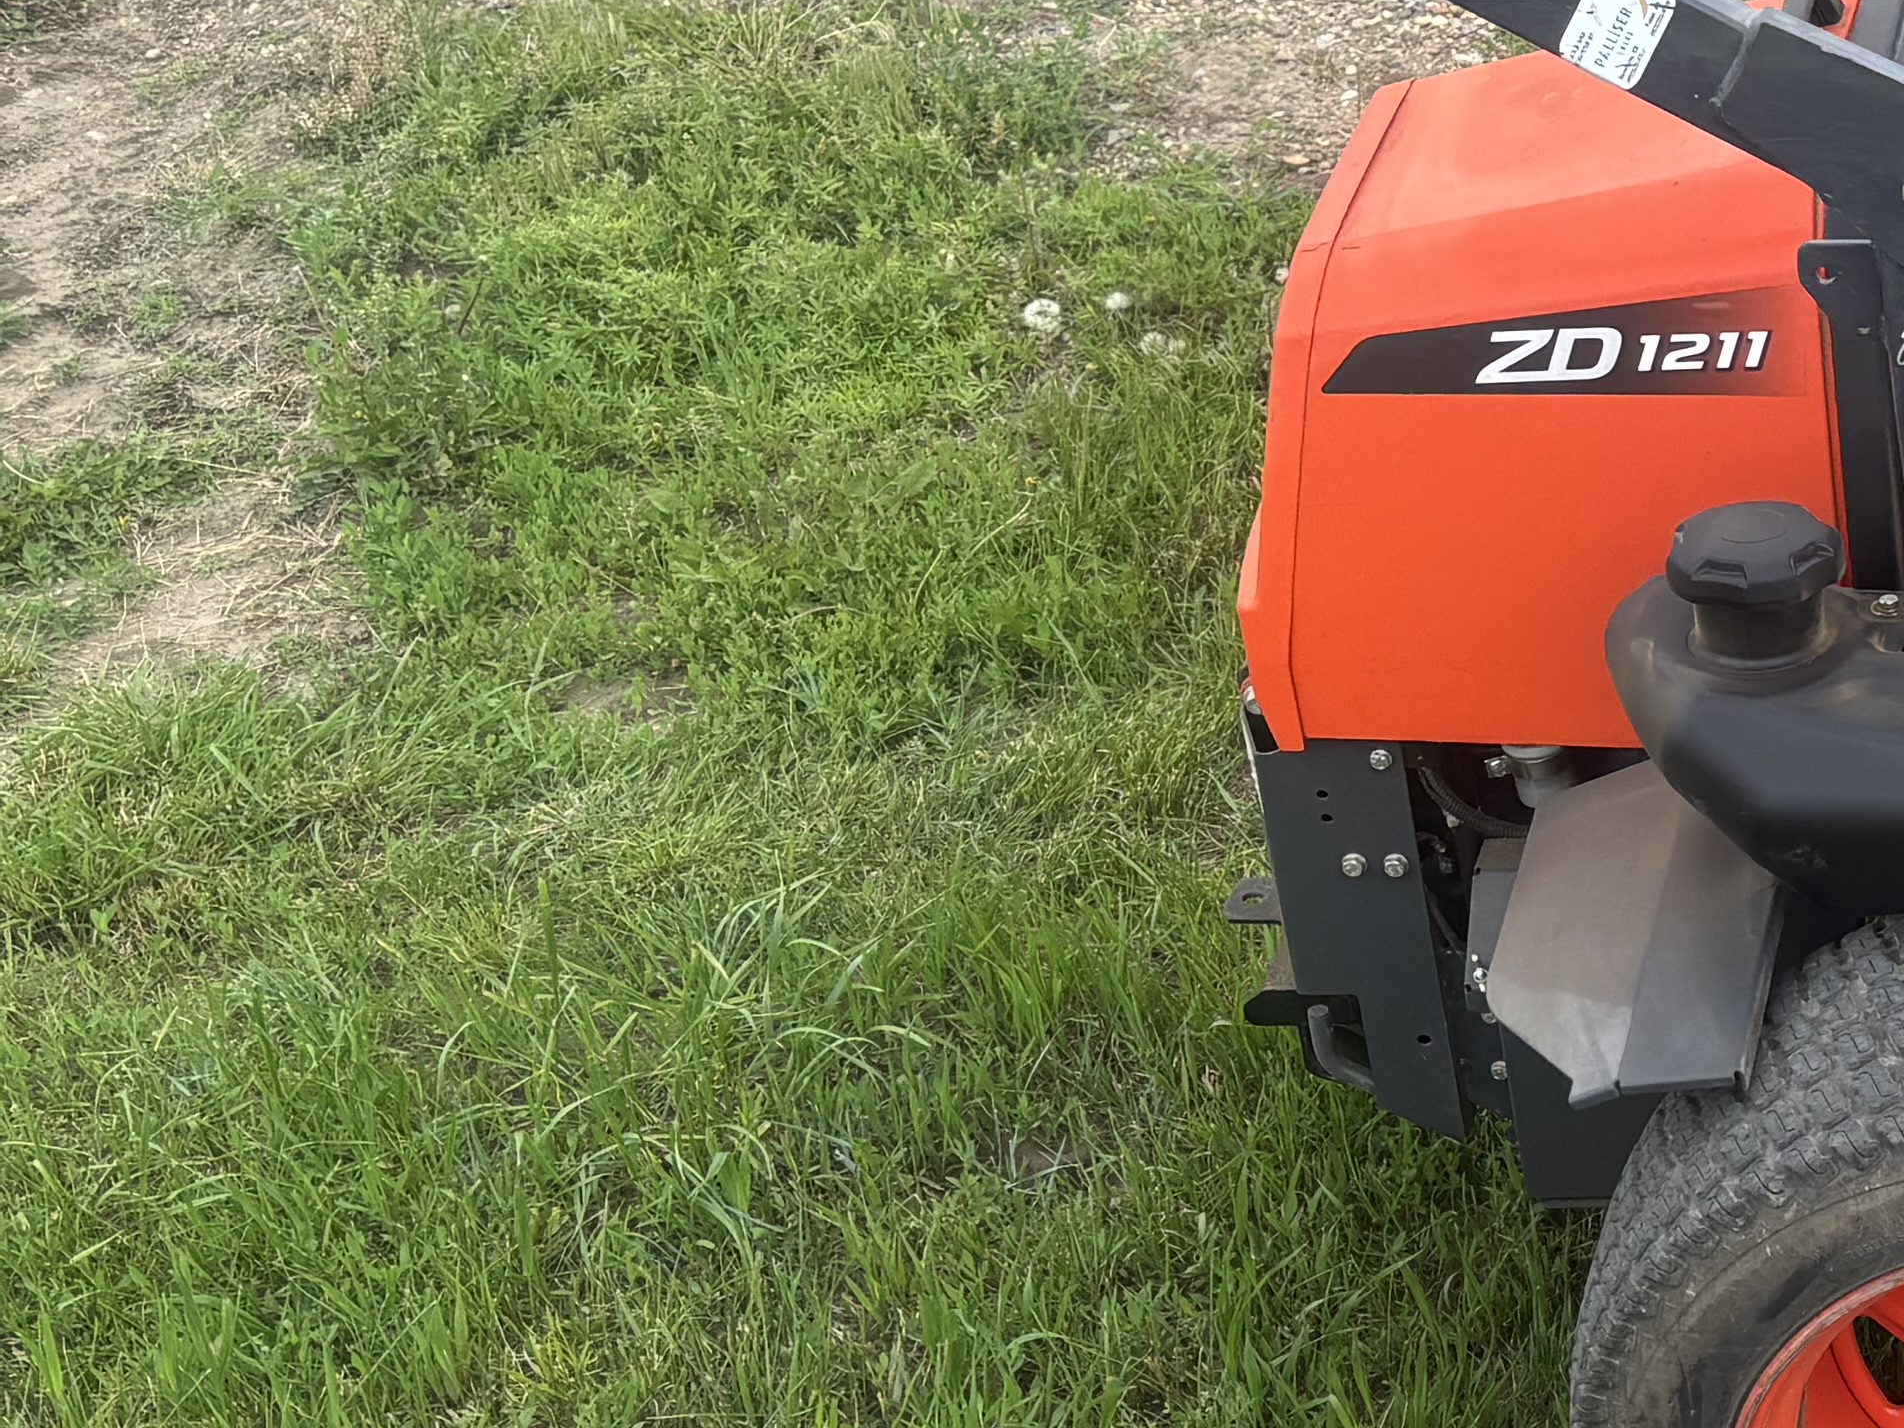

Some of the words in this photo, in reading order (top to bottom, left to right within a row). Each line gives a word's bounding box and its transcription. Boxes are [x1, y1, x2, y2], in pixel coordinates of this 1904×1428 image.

[1594, 6, 1633, 68] PALLISER
[1475, 327, 1623, 384] ZD
[1637, 330, 1770, 372] 1211
